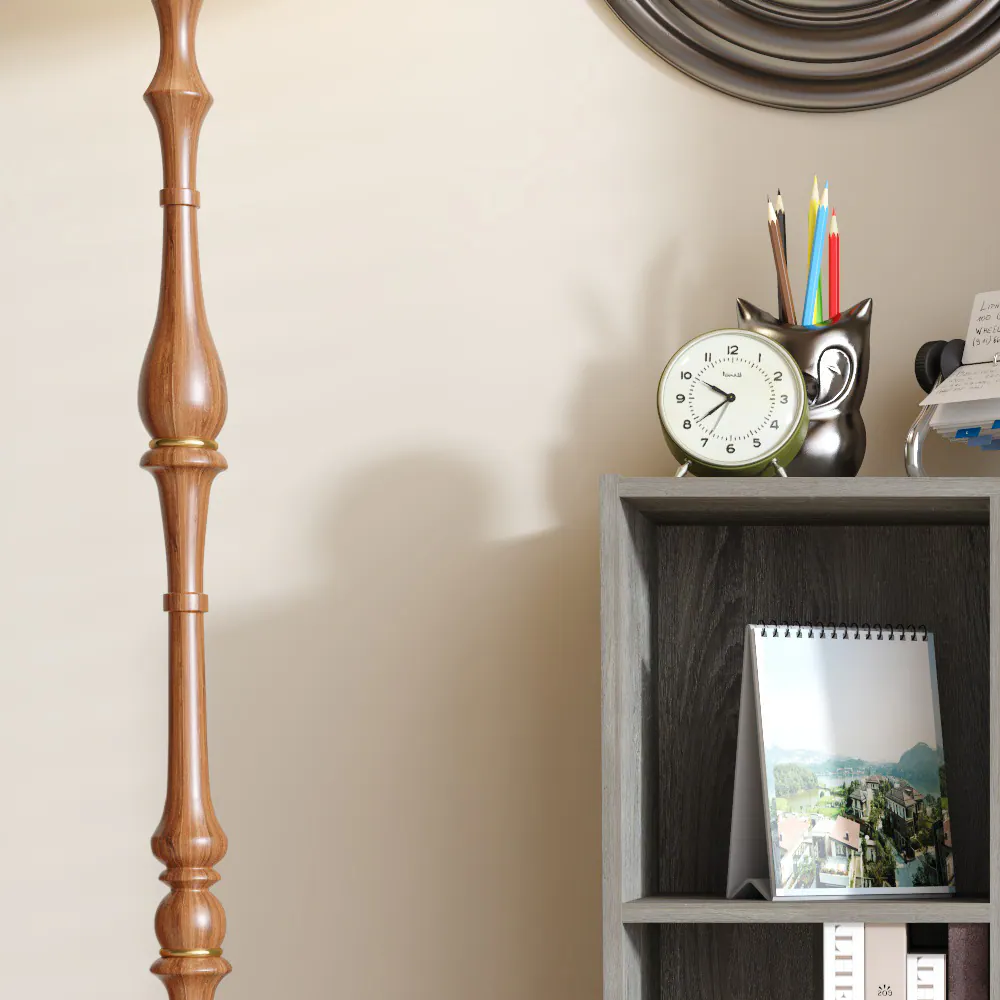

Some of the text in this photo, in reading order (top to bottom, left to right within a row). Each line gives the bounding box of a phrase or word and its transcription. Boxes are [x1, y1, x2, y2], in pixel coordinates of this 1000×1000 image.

[727, 345, 739, 356] 12
[705, 352, 712, 362] 11
[758, 353, 762, 362] 1
[680, 371, 692, 380] 10
[774, 372, 782, 382] 2
[676, 394, 686, 404] 9
[780, 394, 788, 404] 3
[683, 420, 692, 430] 8
[770, 420, 780, 430] 4
[700, 438, 708, 448] 7
[752, 438, 762, 448] 5
[726, 444, 736, 454] 6
